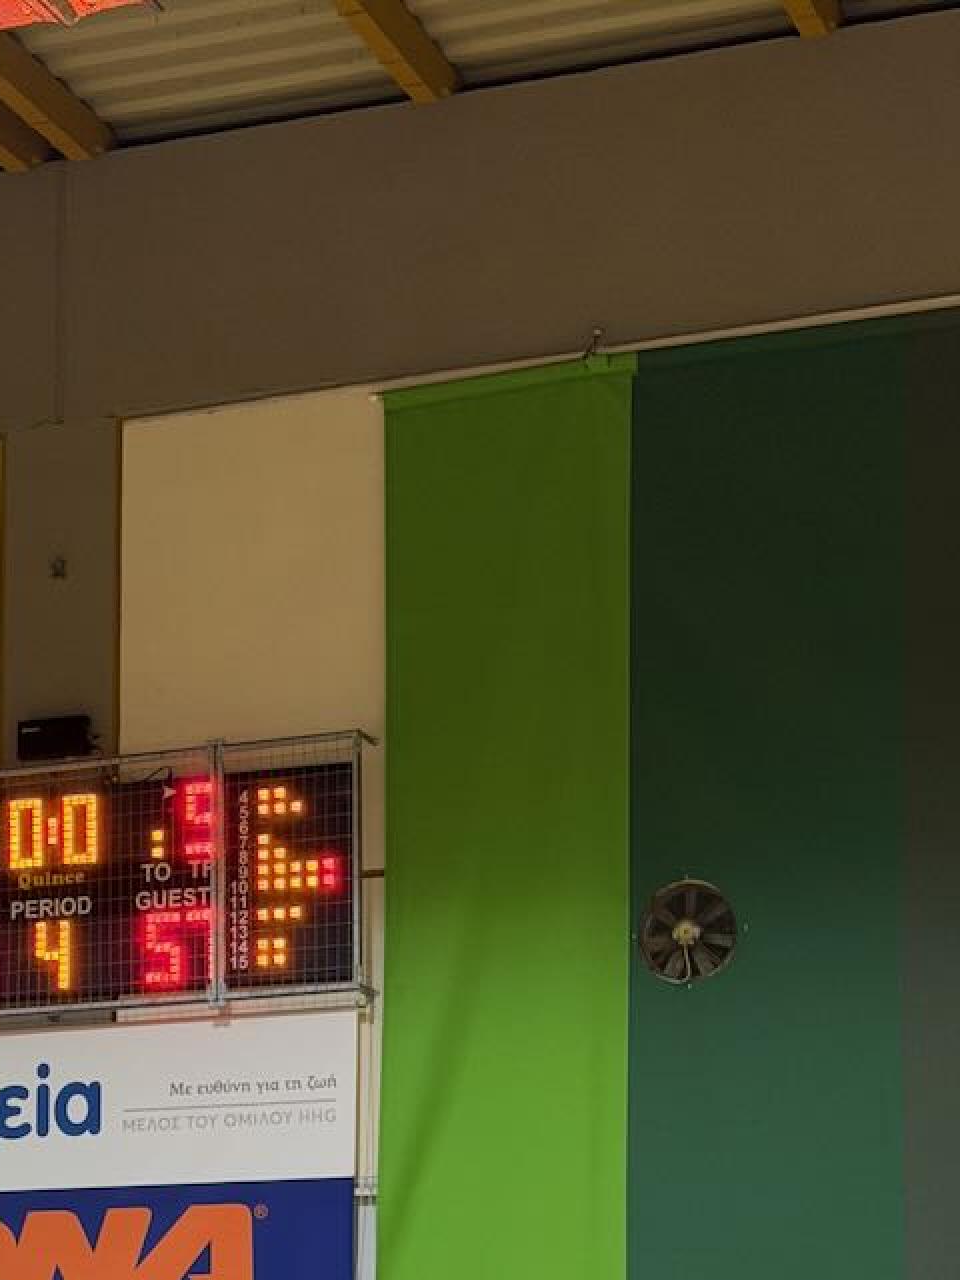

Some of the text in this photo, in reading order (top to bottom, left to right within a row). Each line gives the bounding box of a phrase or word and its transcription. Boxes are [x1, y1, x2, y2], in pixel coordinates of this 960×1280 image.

[141, 862, 171, 882] TO
[10, 896, 93, 920] PERIOD
[136, 887, 212, 910] GUEST
[35, 921, 70, 988] 4
[145, 908, 214, 983] 57
